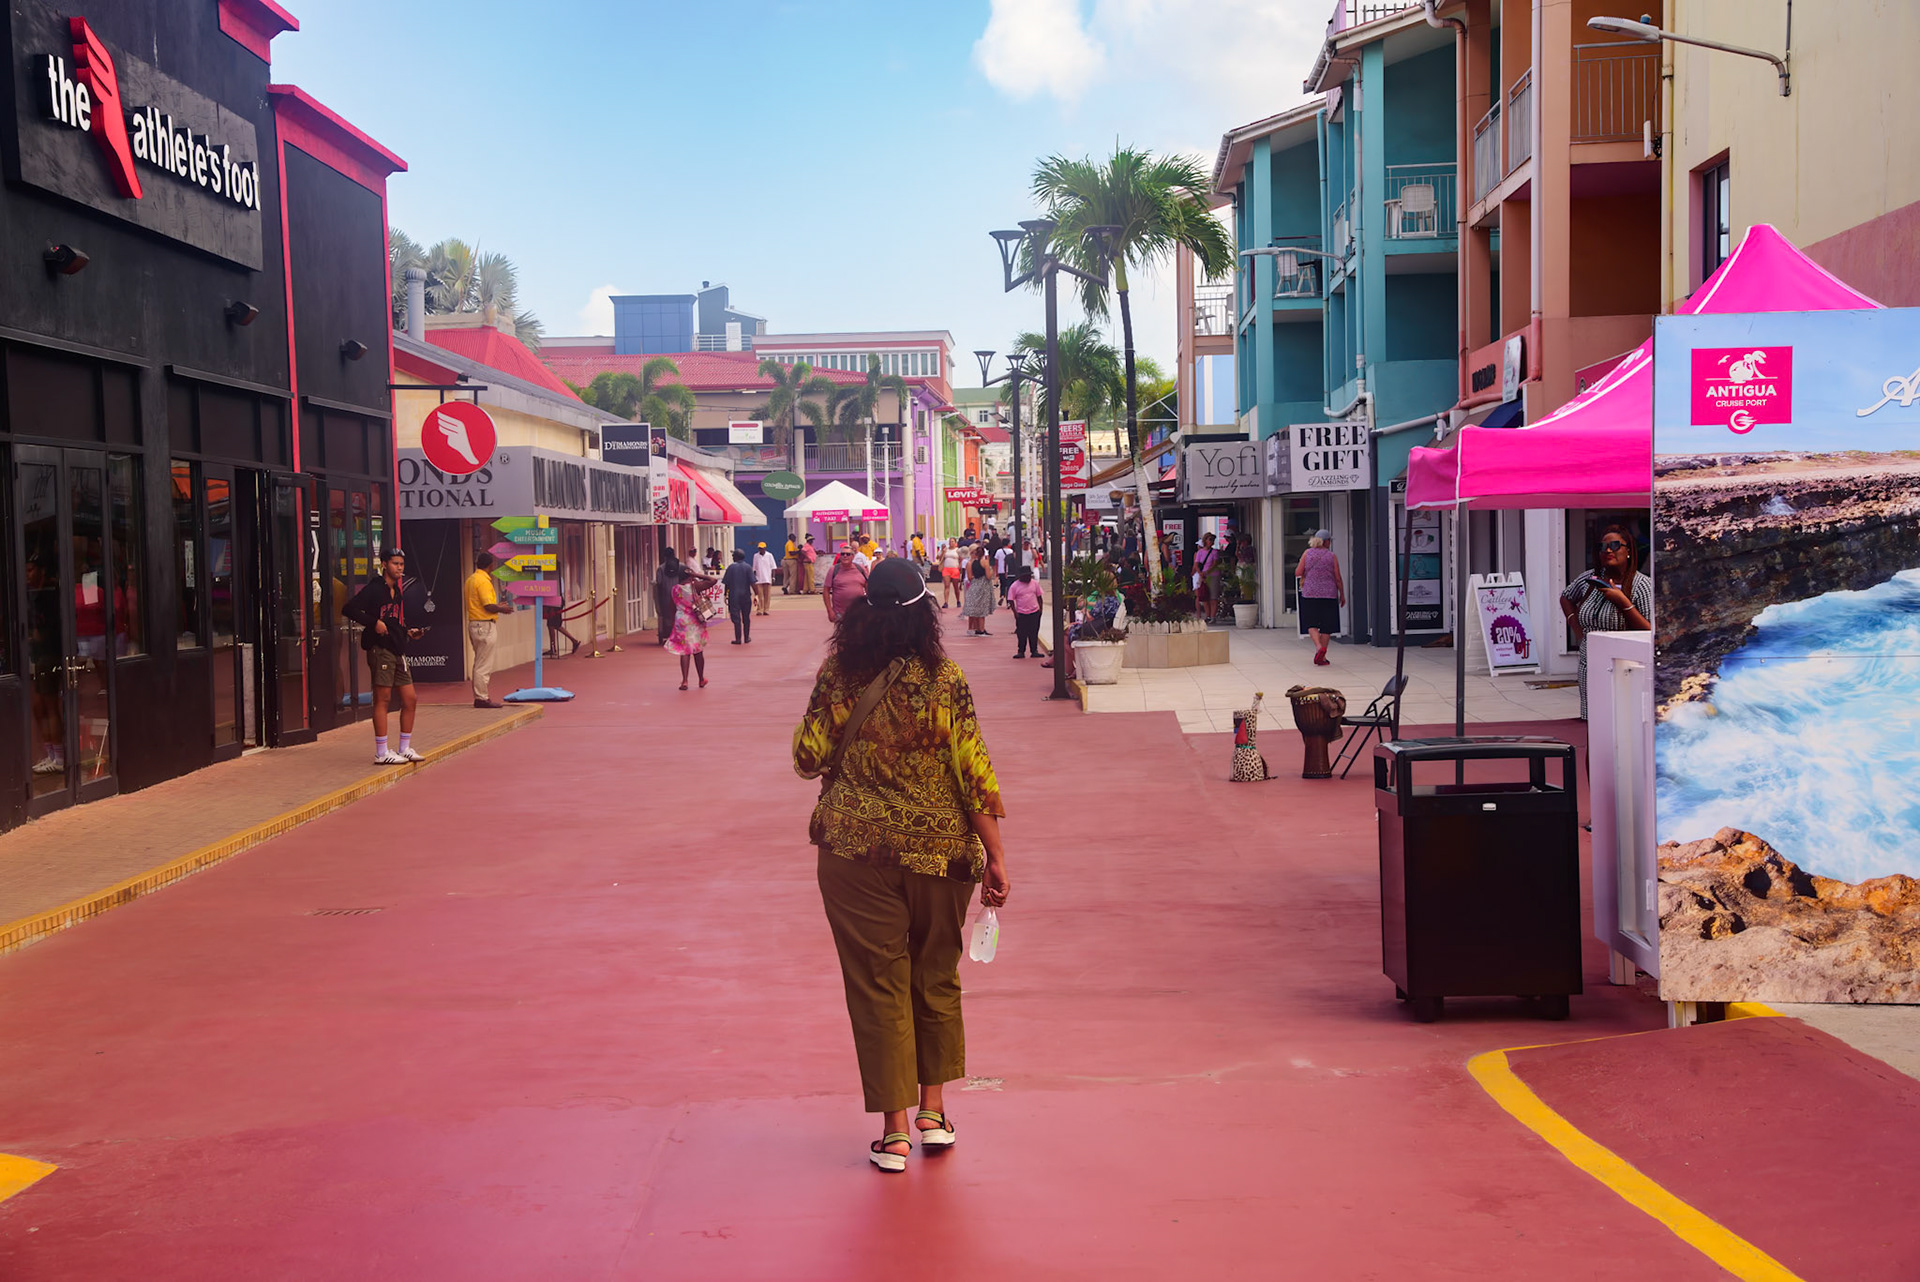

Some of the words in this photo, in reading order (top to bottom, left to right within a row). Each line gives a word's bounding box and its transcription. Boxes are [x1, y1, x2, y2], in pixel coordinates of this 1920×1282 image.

[48, 54, 91, 131] the
[134, 105, 221, 194] athlete's
[223, 145, 261, 211] foot
[1706, 384, 1777, 398] ANTIGUA
[1715, 399, 1744, 407] CRUISE
[1745, 398, 1767, 407] PORT
[1299, 425, 1367, 447] FREE
[1196, 445, 1259, 477] Yofi
[1303, 450, 1365, 471] GIFT
[1495, 626, 1522, 644] 20%
